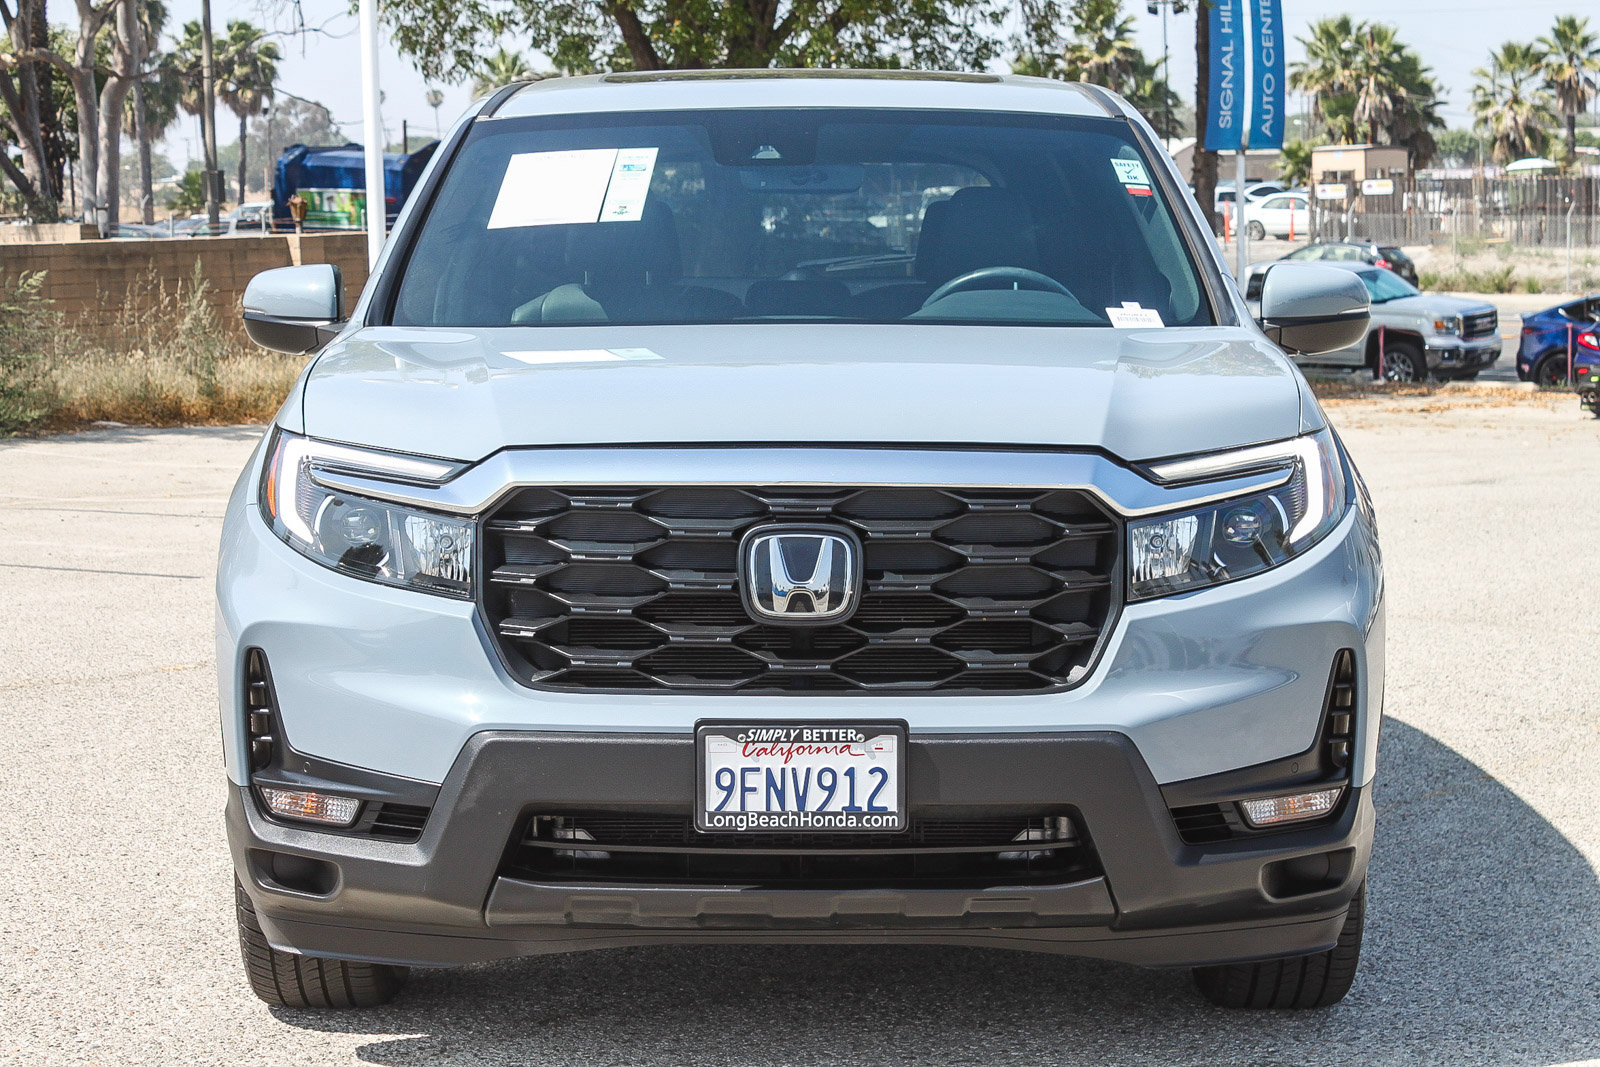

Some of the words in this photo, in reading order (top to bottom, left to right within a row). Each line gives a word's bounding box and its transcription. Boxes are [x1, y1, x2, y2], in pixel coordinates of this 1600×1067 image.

[1218, 40, 1234, 129] SIGNAL
[1261, 73, 1276, 137] AUTO
[746, 729, 799, 742] SIMPLY
[802, 729, 857, 742] BETTER
[742, 742, 865, 764] California
[714, 766, 889, 812] 9FNV912
[704, 811, 899, 831] LongBeachHonda.com
